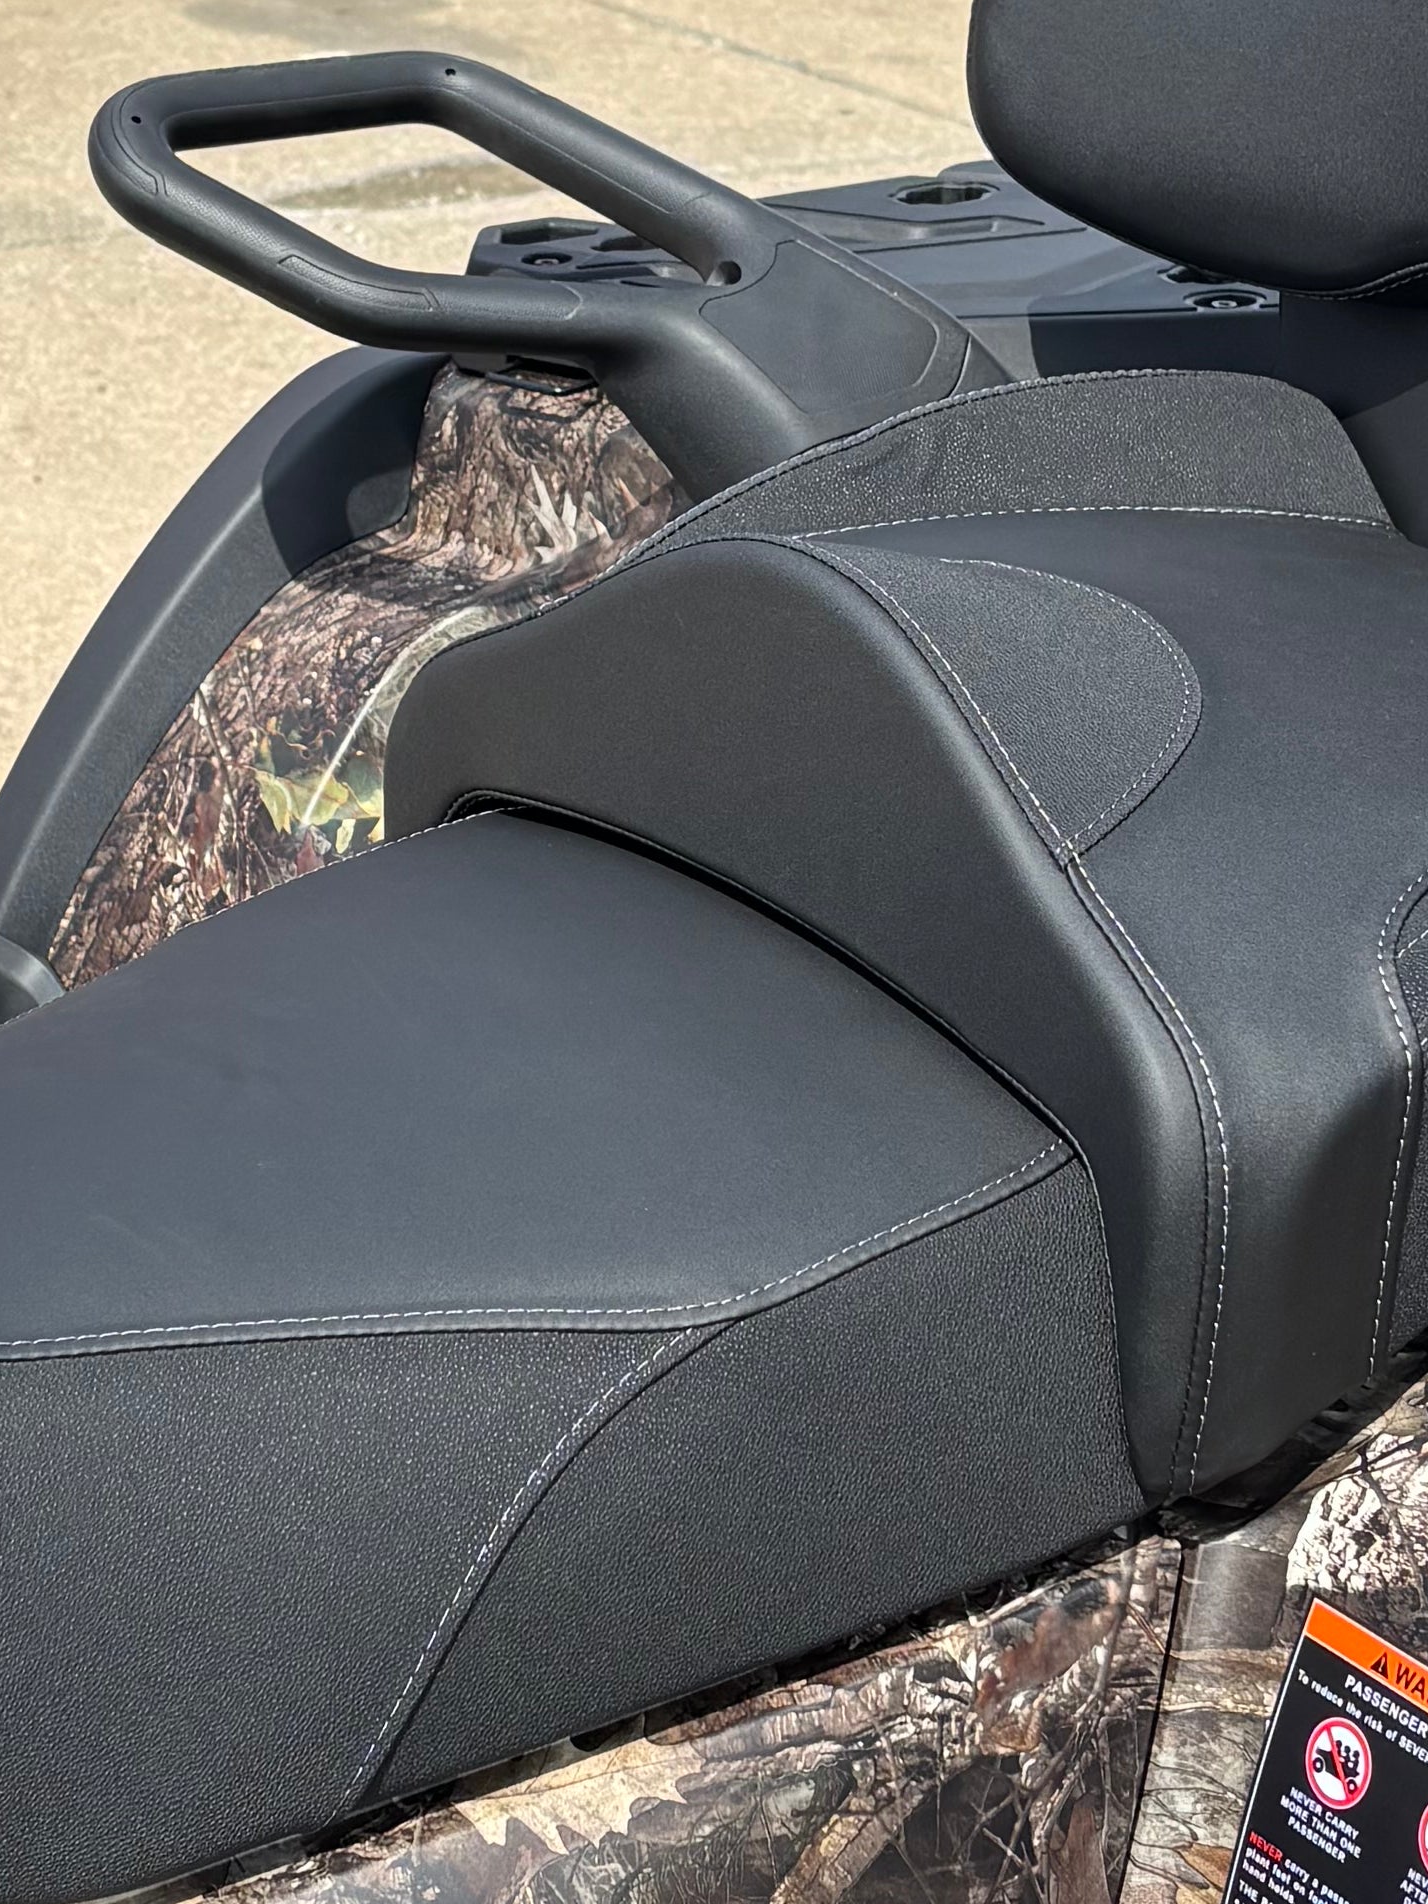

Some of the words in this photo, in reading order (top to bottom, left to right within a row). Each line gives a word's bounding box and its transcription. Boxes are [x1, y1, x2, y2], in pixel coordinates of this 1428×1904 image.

[1297, 1668, 1309, 1684] To
[1310, 1680, 1343, 1707] reduce
[1345, 1701, 1361, 1719] the
[1363, 1714, 1382, 1733] risk
[1385, 1729, 1398, 1741] of
[1344, 1675, 1428, 1737] PASSENGER
[1280, 1795, 1309, 1822] MORE
[1311, 1815, 1337, 1841] THAN
[1339, 1836, 1361, 1858] ONE
[1288, 1816, 1345, 1862] PASSENGER
[1289, 1787, 1322, 1816] NEVER
[1325, 1811, 1358, 1839] CARRY
[1245, 1847, 1270, 1869] plant
[1271, 1863, 1291, 1884] feet
[1292, 1881, 1305, 1895] on
[1249, 1831, 1282, 1861] NEVER
[1284, 1858, 1309, 1883] carry
[1311, 1878, 1318, 1888] a
[1239, 1879, 1258, 1902] THE
